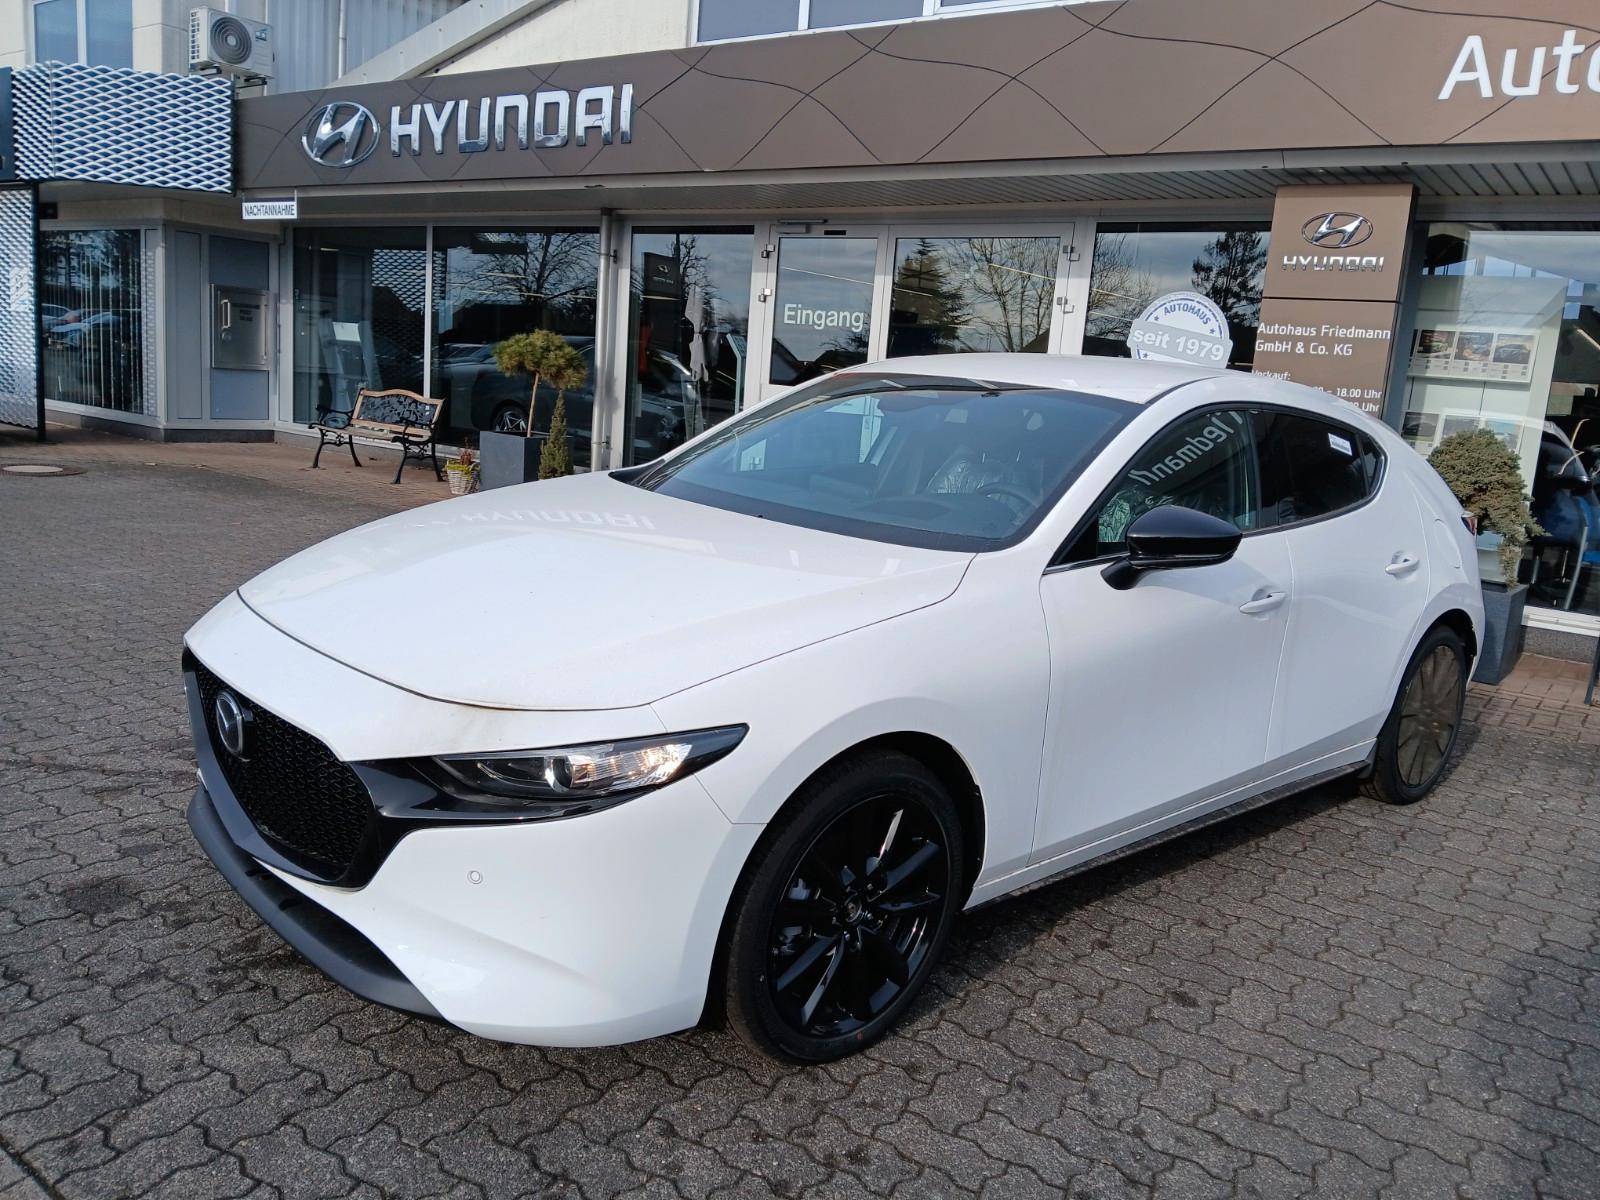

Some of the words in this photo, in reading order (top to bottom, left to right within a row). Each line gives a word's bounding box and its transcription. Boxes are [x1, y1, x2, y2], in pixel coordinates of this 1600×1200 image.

[390, 83, 633, 157] HYUNDAI
[244, 204, 295, 217] NACHTANNAHME
[1281, 255, 1385, 272] HYUNDAI
[783, 303, 864, 332] Eingang
[1164, 303, 1211, 325] AUTOHAUS
[1257, 322, 1317, 336] Autohaus
[1321, 325, 1391, 339] Friedmann
[1133, 329, 1170, 349] seit
[1176, 335, 1224, 361] 1979
[1255, 340, 1292, 353] GmbH
[1295, 341, 1305, 354] &
[1309, 342, 1329, 355] Co.
[1333, 343, 1353, 356] KG
[1336, 387, 1361, 398] 18.00
[1364, 389, 1382, 399] Uhr
[1362, 402, 1380, 412] Uhr
